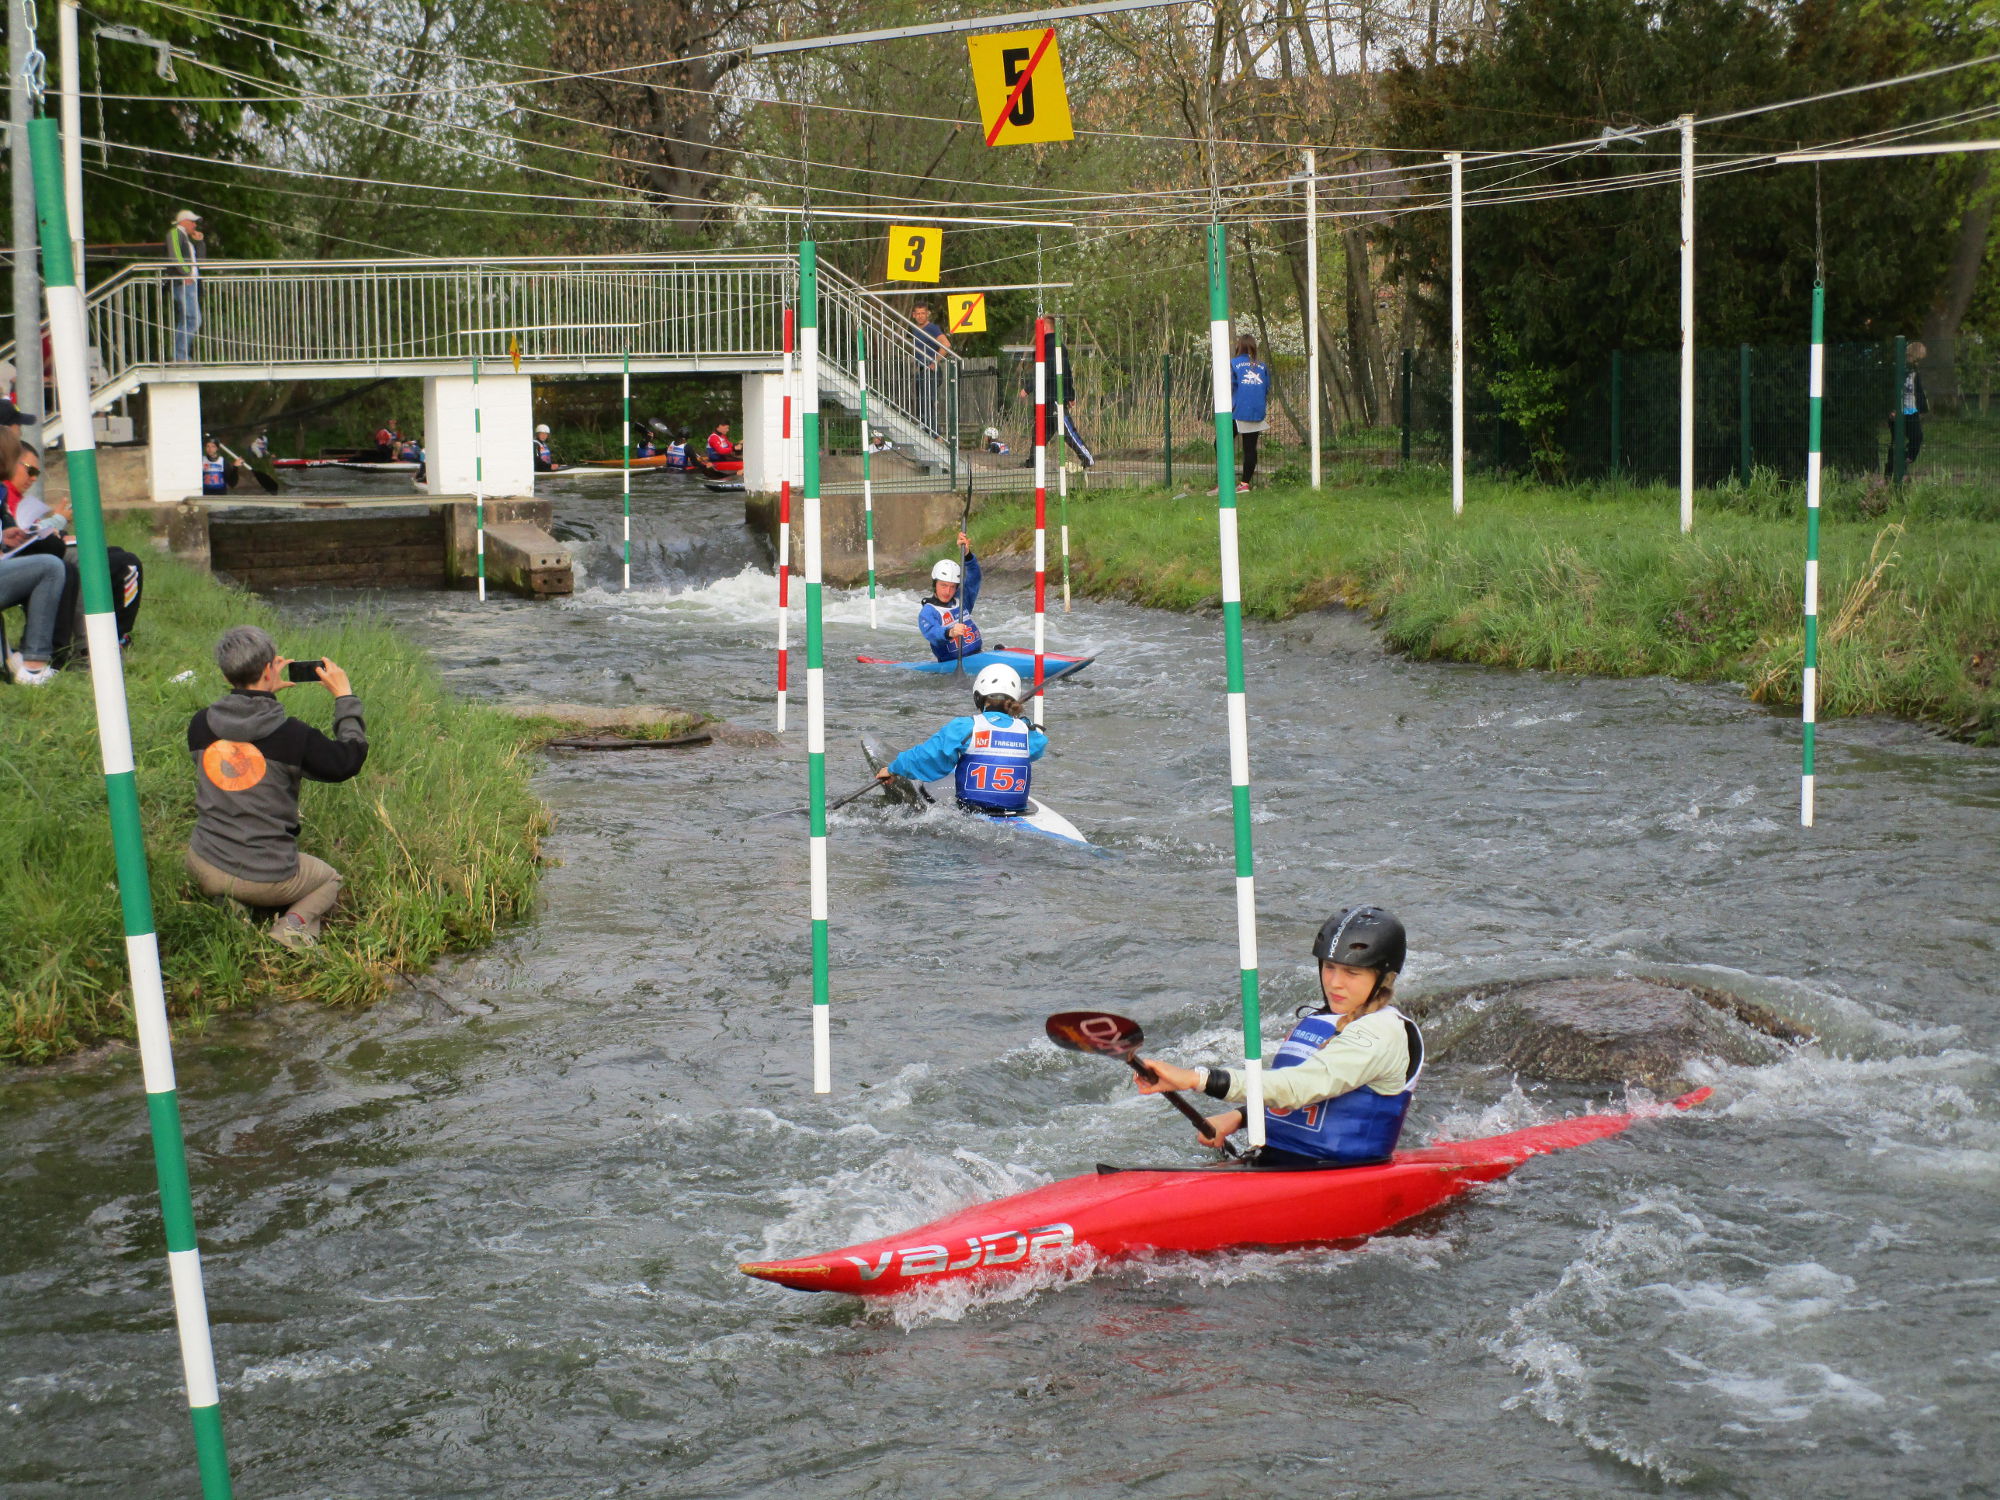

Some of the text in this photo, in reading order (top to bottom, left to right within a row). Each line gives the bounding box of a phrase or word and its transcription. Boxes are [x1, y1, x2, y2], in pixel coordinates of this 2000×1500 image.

[1002, 47, 1035, 127] 5
[903, 235, 926, 273] 3
[960, 300, 976, 327] 2
[845, 1222, 1075, 1281] VAJDA
